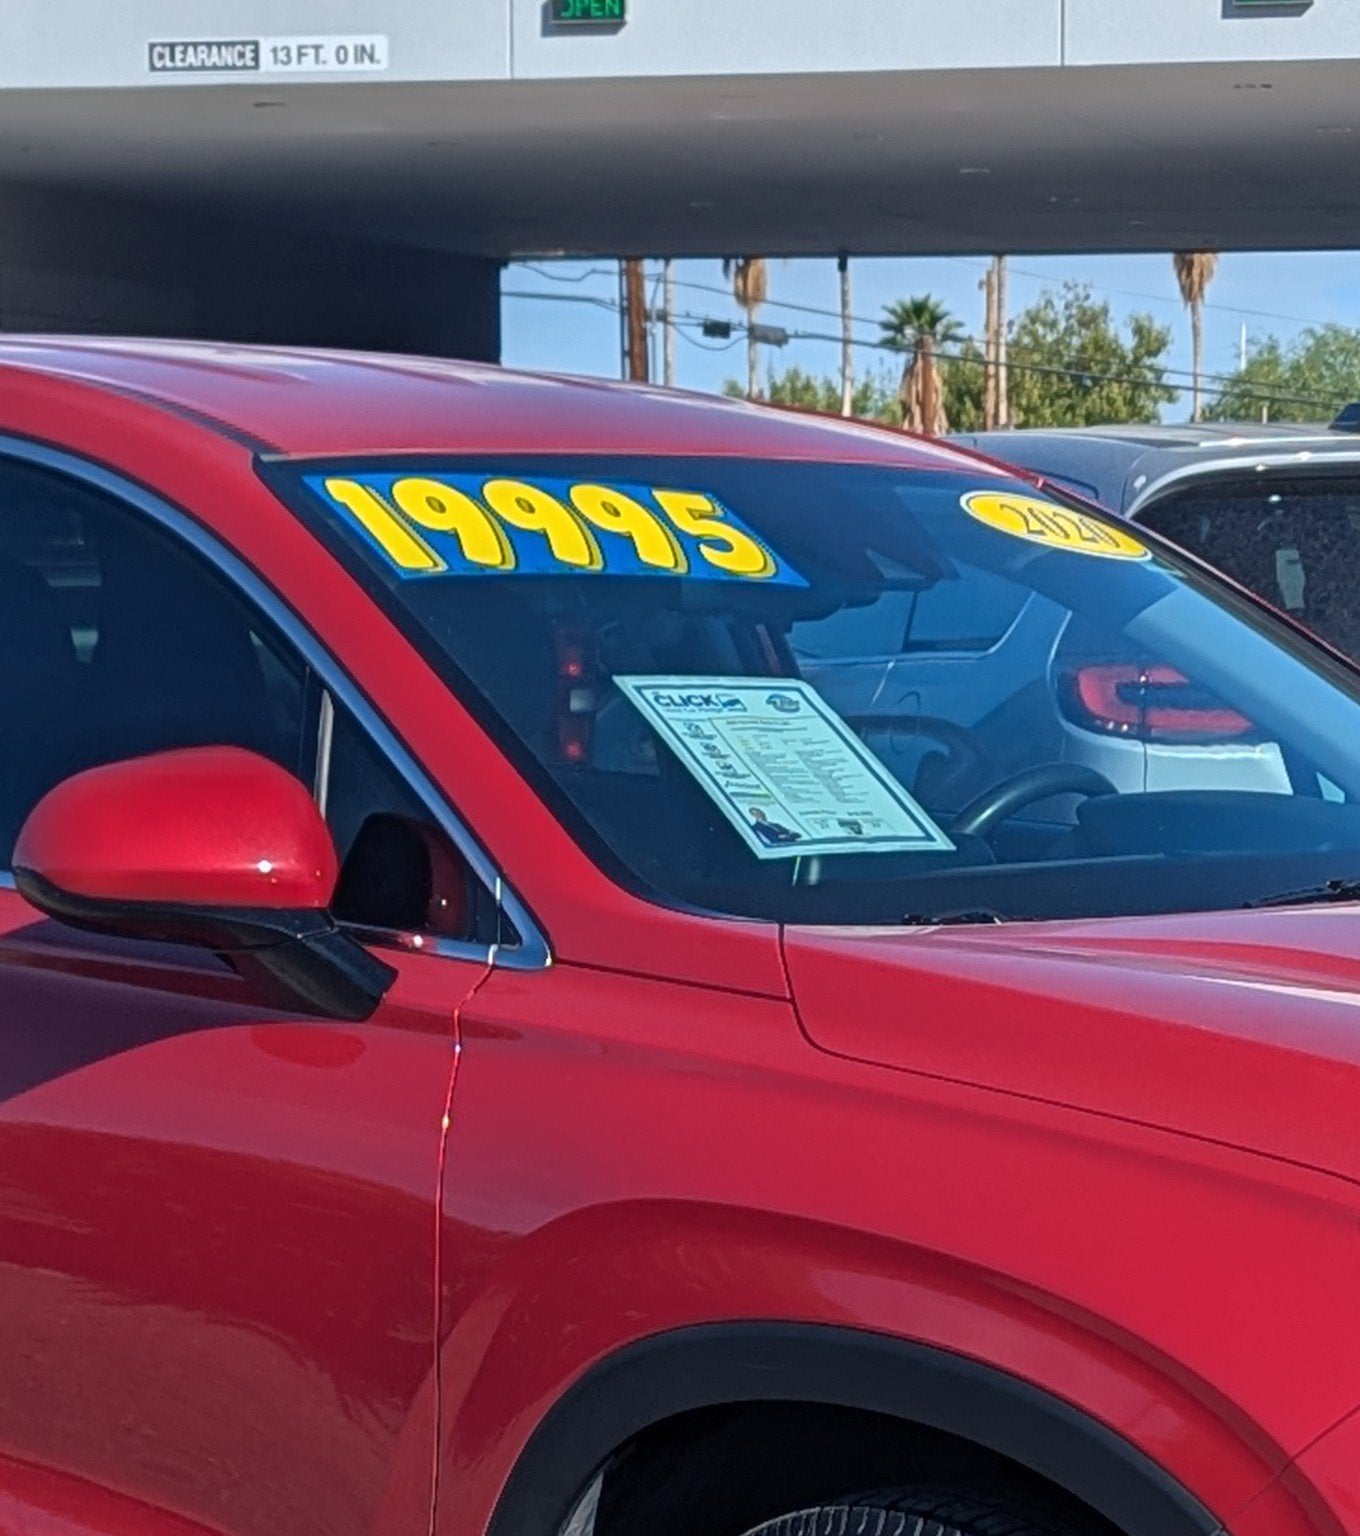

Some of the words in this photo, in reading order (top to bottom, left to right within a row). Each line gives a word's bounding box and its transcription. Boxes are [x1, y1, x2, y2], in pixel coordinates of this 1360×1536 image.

[152, 44, 256, 68] CLEARANCE
[270, 45, 291, 65] 13
[297, 44, 327, 65] FT.
[335, 45, 348, 65] 0
[354, 43, 381, 64] IN.
[324, 477, 777, 579] 19995
[1000, 503, 1121, 549] 2020
